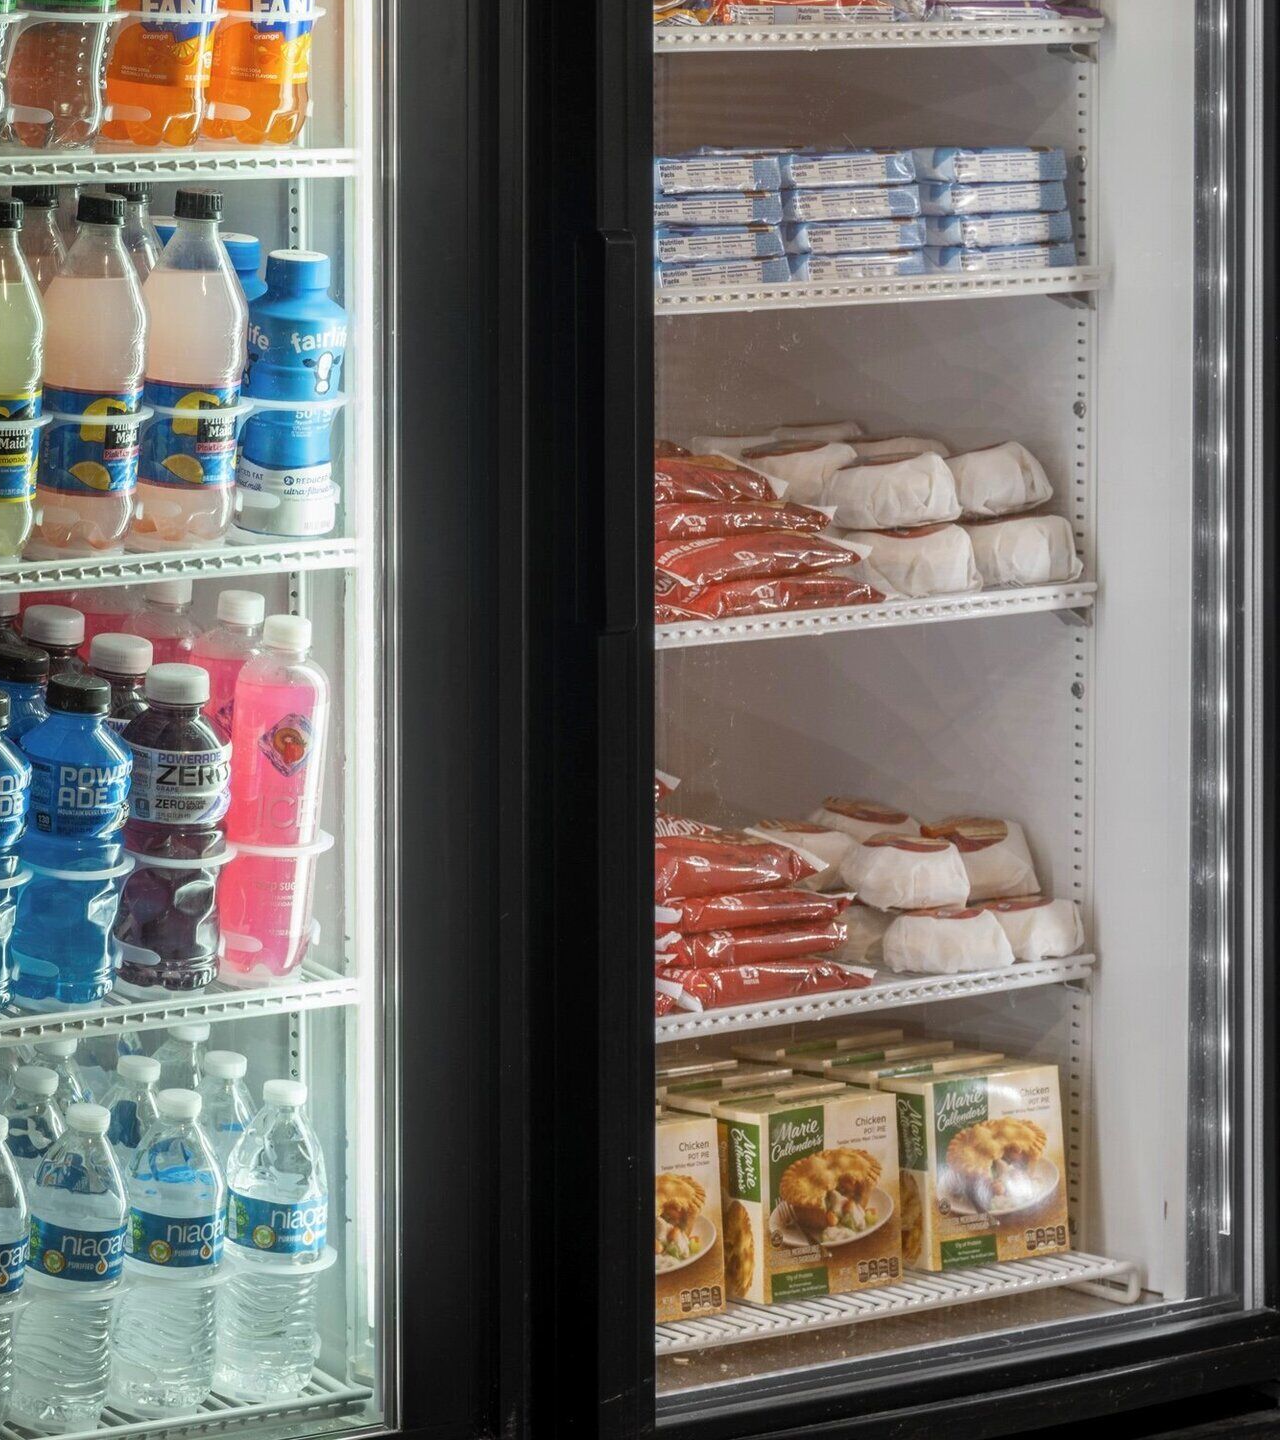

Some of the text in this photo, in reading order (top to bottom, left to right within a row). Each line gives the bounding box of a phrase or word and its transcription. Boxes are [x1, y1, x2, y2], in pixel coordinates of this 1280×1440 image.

[142, 32, 169, 40] orange
[253, 33, 280, 41] orange
[654, 202, 679, 210] Nutrition
[659, 239, 684, 247] Nutrition
[808, 260, 832, 268] Nutrition
[662, 270, 688, 278] Nutrition
[809, 267, 825, 275] Facts
[663, 278, 680, 286] Facts
[115, 431, 138, 444] Maid
[208, 425, 233, 438] Maid
[197, 443, 214, 452] Pink
[252, 472, 264, 481] FAT
[158, 752, 222, 764] POWERADE
[156, 762, 228, 787] ZERO
[58, 786, 110, 808] ADE
[154, 799, 185, 810] ZERO
[1019, 1086, 1050, 1098] Chicken
[937, 1089, 984, 1116] Marie
[855, 1115, 887, 1127] Chicken
[937, 1104, 988, 1132] Callender's
[772, 1118, 819, 1146] Marie
[906, 1099, 924, 1158] Marie
[679, 1140, 710, 1152] Chicken
[771, 1134, 824, 1162] Callender's
[688, 1152, 699, 1160] POT
[730, 1127, 747, 1195] Callender's
[740, 1129, 757, 1191] Marie
[61, 1231, 127, 1275] niagar
